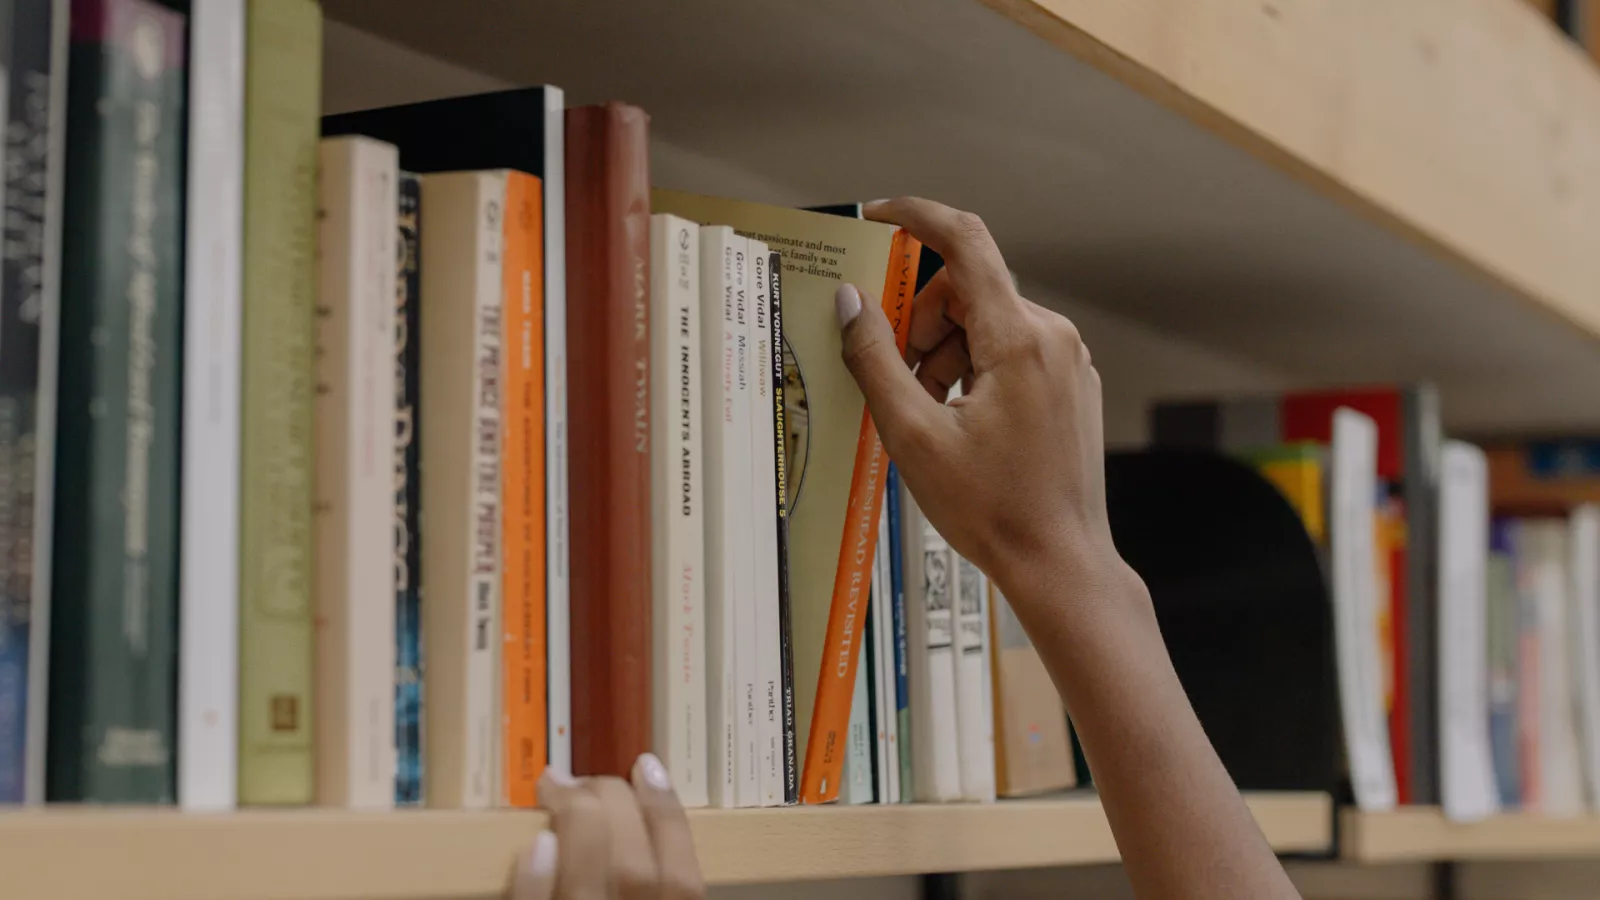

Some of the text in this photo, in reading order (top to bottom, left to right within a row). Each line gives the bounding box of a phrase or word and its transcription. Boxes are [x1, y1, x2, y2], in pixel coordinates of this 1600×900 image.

[758, 231, 803, 246] passionate
[805, 241, 822, 251] and
[824, 245, 846, 255] most
[790, 251, 819, 264] family
[821, 256, 838, 266] was
[893, 254, 911, 334] EVELYN
[634, 256, 648, 454] MARK TWAIN
[725, 246, 734, 423] Gore Vidal A Thirsty Evil
[736, 251, 747, 391] Gore Vidal Messiah
[756, 256, 768, 397] Gore Vidal Williwaw
[680, 306, 692, 516] THE INNOCENTS ABROAD
[772, 273, 786, 518] KURT VONNEGUT SLAUGHTERHOUSE 5
[682, 562, 693, 686] Mark Twain
[838, 571, 863, 678] REVISITED
[767, 680, 776, 722] Panther
[787, 730, 795, 791] GRANADA
